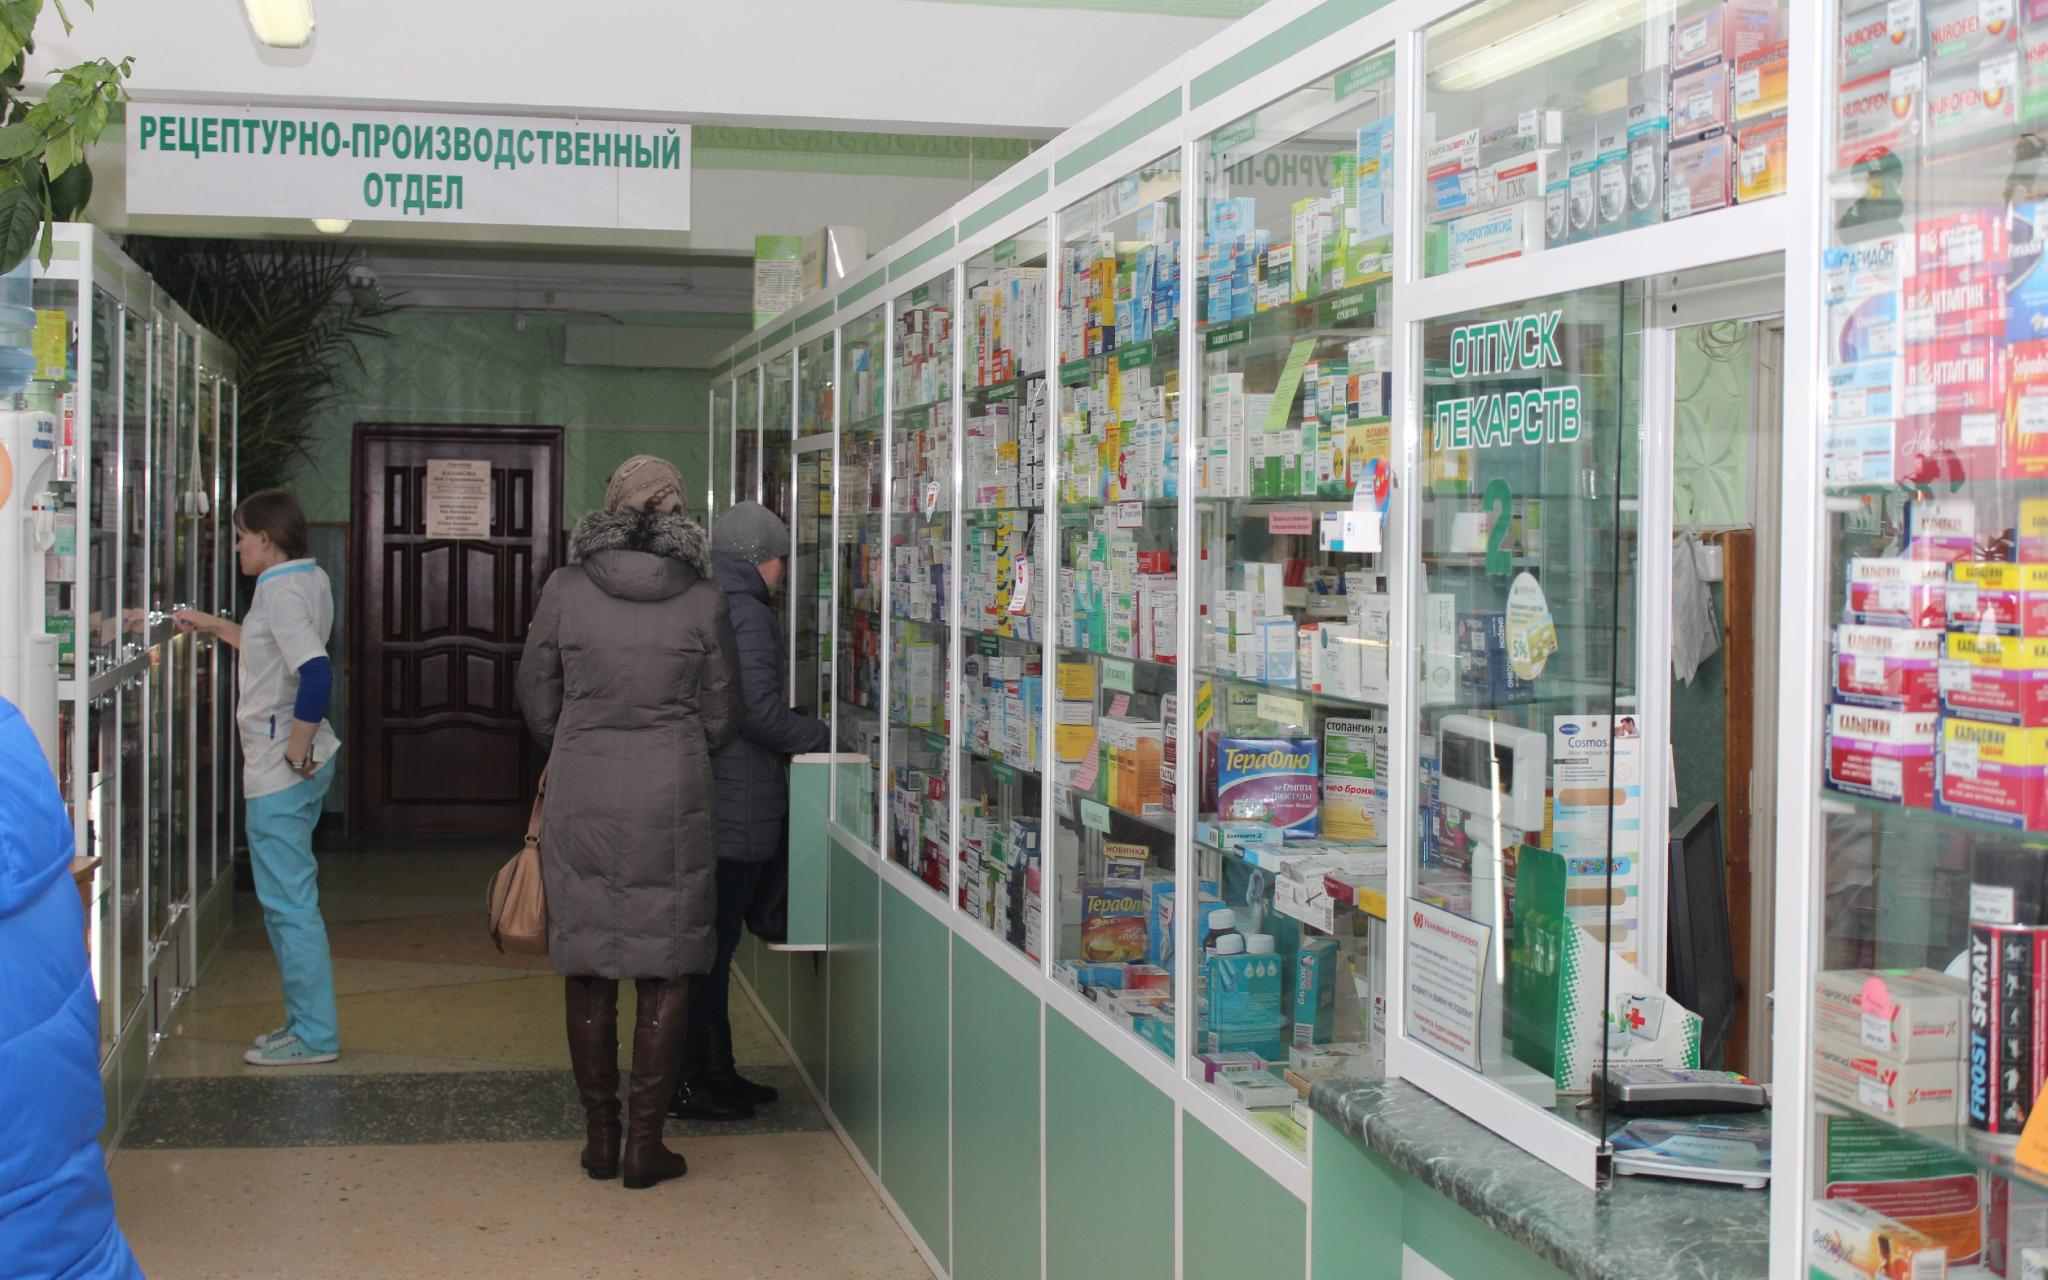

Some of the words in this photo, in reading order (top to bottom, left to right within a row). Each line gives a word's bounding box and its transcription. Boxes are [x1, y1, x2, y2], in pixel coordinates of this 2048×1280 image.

[1843, 21, 1887, 45] NUROFEN
[1842, 92, 1889, 118] NUROFEN
[1929, 89, 1982, 116] NUROFEN
[139, 114, 682, 170] РЕЦЕПТУРНО-ПРОИЗВОДСТВЕННЫЙ
[363, 171, 464, 215] ОТДЕЛ
[1451, 310, 1562, 378] ОТПУСК
[1434, 385, 1582, 451] ЛЕКАРСТВ
[1482, 476, 1513, 576] 2
[1839, 715, 1891, 736] КАЛЬЦЕМИН
[1954, 725, 2006, 745] КАЛЬЦЕМИН
[1568, 737, 1608, 748] Cosmos
[1224, 748, 1312, 774] ТераФлю
[1106, 845, 1146, 856] НОВИНКА
[1970, 935, 1990, 1028] SPRAY
[1969, 1034, 1989, 1121] FROST
